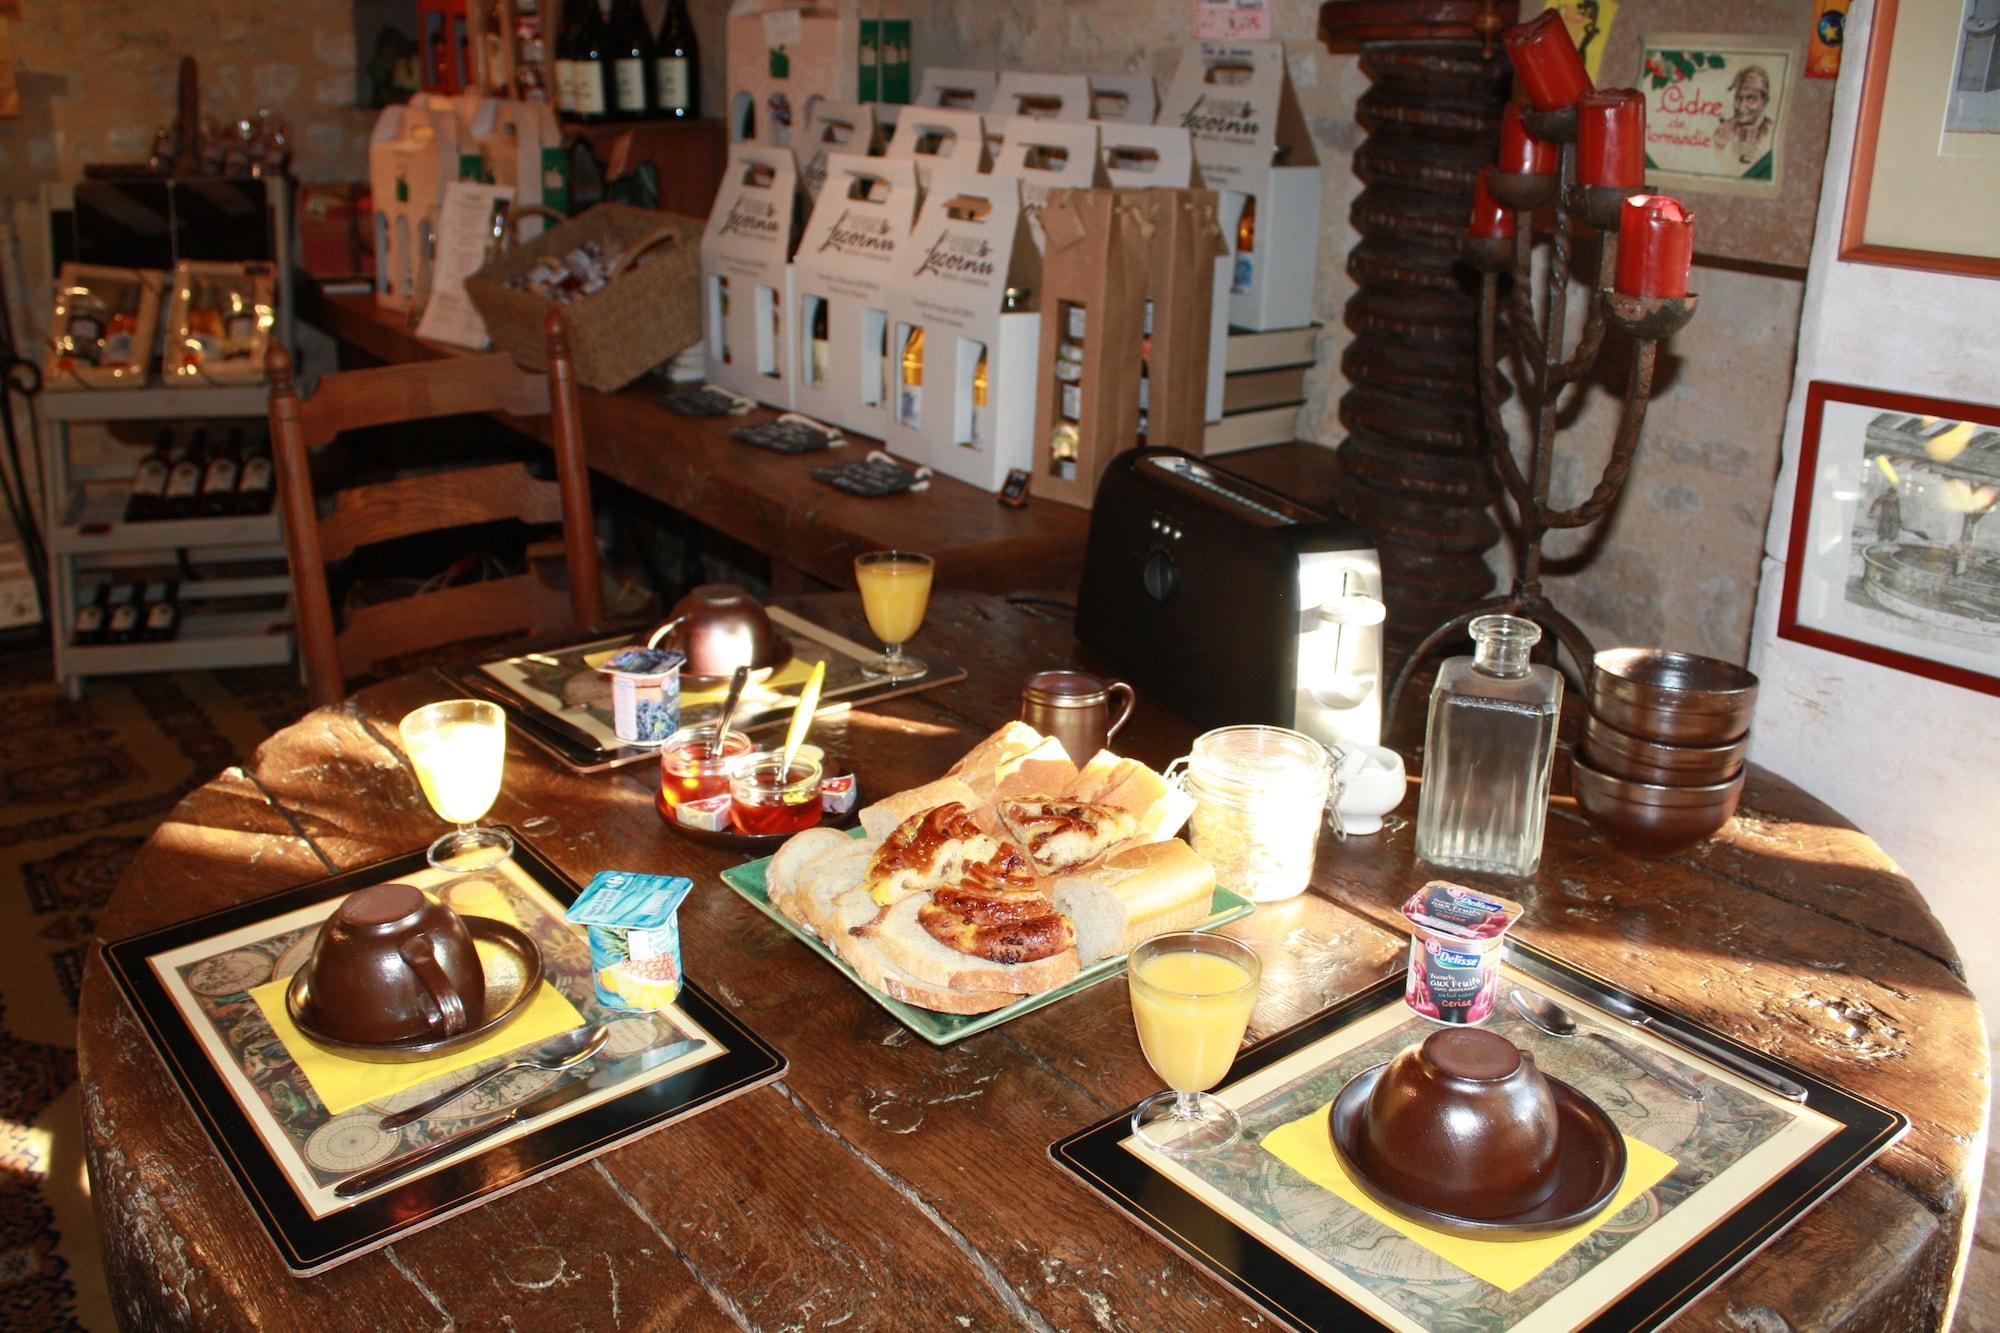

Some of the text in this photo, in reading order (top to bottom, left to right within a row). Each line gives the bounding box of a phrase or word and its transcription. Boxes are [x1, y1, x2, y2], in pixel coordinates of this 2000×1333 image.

[1656, 85, 1723, 116] Cidre
[1646, 124, 1713, 148] ormandie
[912, 227, 994, 277] Lecornu
[1430, 979, 1449, 988] aux
